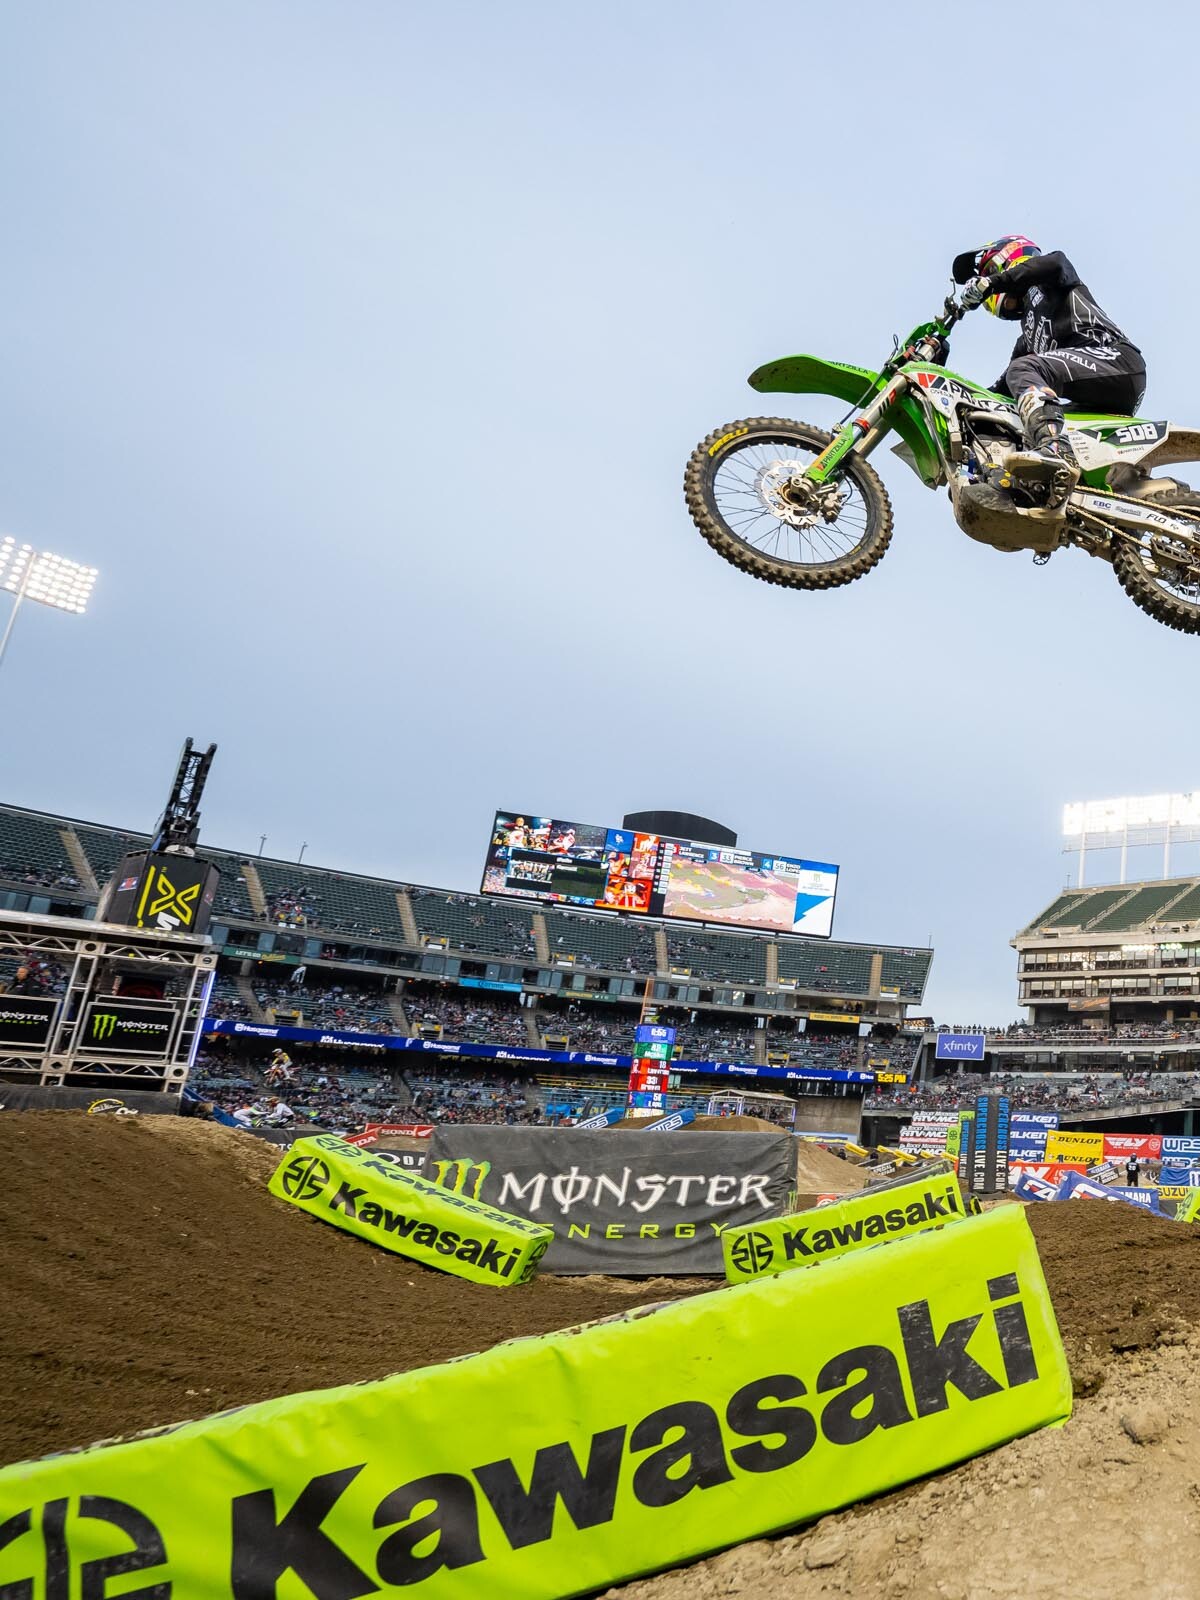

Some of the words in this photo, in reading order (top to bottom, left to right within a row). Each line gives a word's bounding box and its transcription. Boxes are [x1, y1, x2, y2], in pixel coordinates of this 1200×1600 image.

[1116, 423, 1159, 443] 508
[708, 427, 748, 457] PIRELLI
[822, 434, 850, 467] PARTZILLA
[1093, 500, 1112, 509] EBC
[116, 1021, 169, 1031] MONSTER
[944, 1040, 978, 1053] xfinity
[878, 1073, 894, 1083] 5:25
[894, 1074, 907, 1083] PM
[1011, 1114, 1058, 1124] FALKEN
[1010, 1131, 1048, 1139] ALKEN
[1057, 1136, 1102, 1145] DUNLOP
[362, 1159, 543, 1235] Kawasaki
[499, 1166, 777, 1214] MONSTER
[1158, 1187, 1189, 1197] SUZU
[330, 1181, 522, 1279] Kawasaki
[783, 1187, 958, 1261] Kawasaki
[230, 1271, 1041, 1600] Kawasaki
